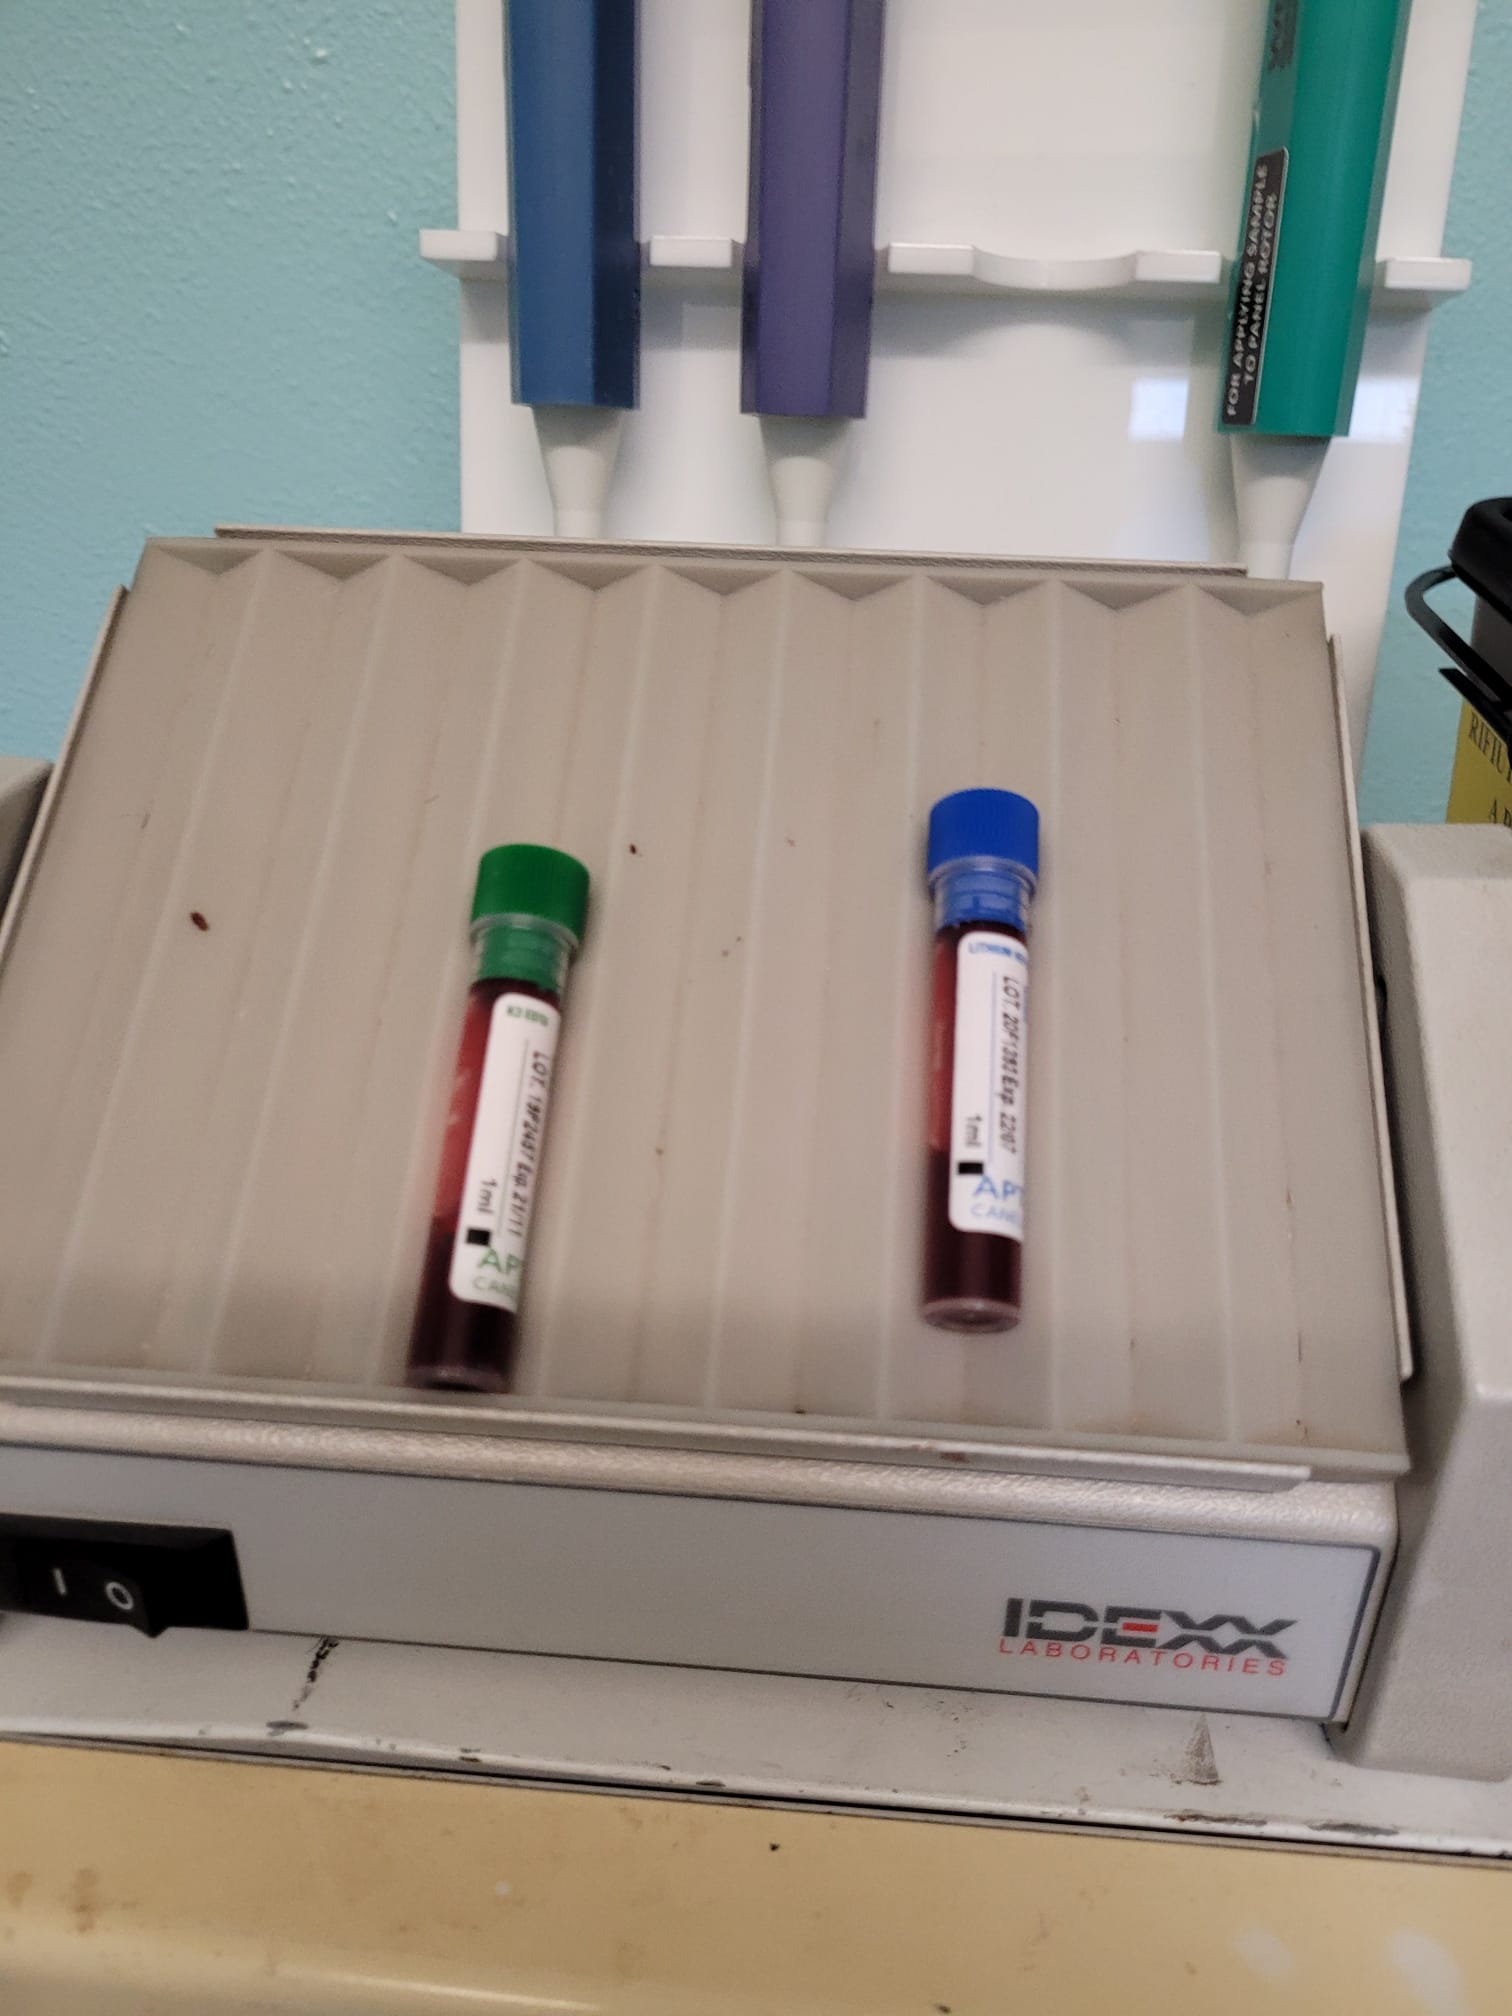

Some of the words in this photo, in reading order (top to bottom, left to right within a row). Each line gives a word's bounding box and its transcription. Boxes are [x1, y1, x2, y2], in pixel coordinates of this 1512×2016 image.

[1245, 163, 1268, 257] SAMPLE
[1257, 193, 1278, 274] ROTOR
[1232, 261, 1256, 369] APPLYING
[1248, 278, 1266, 349] PANEL
[1243, 354, 1256, 384] TO
[1226, 373, 1241, 416] FOR
[965, 1114, 983, 1148] 1ml
[477, 1179, 498, 1215] 1ml
[478, 1247, 524, 1275] AP
[1003, 1597, 1299, 1660] IDEXX
[999, 1637, 1287, 1676] LABORATORIES
